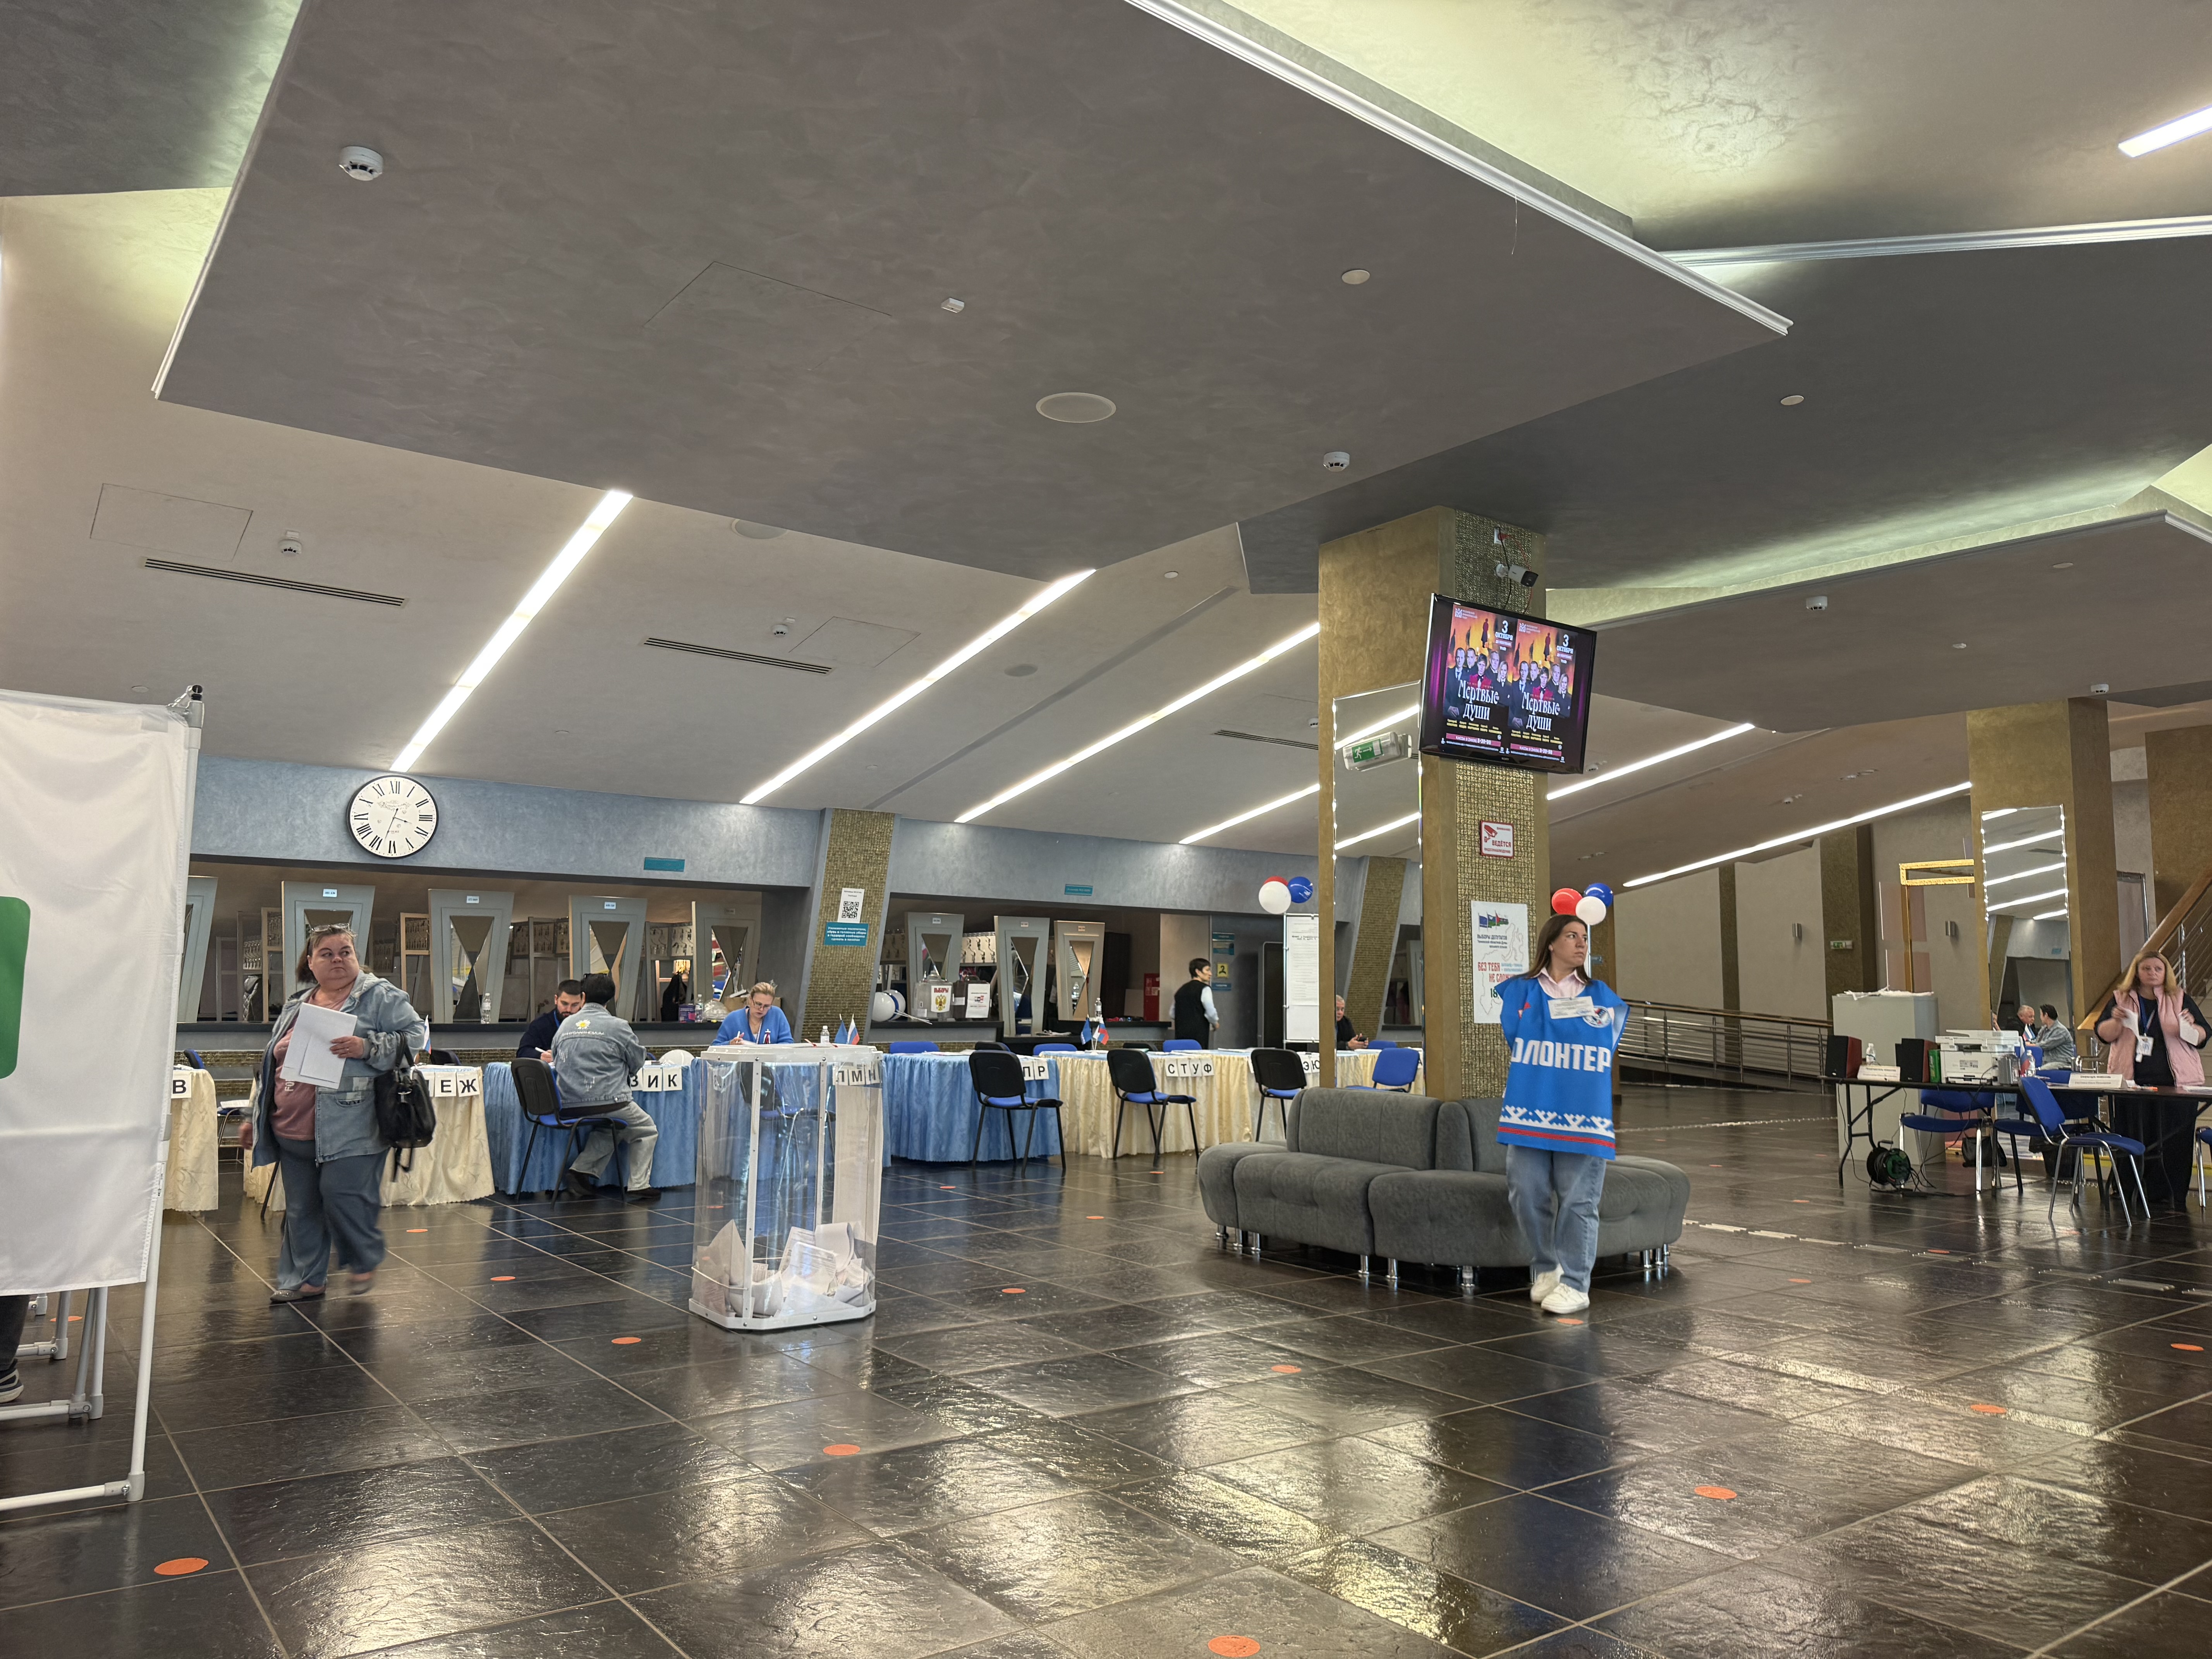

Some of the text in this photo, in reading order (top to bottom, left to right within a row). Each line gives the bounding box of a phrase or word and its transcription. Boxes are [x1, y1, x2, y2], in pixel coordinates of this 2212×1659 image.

[1502, 620, 1508, 633] 3
[1495, 632, 1513, 641] ОКТЯБРЯ
[1563, 634, 1569, 647] 3
[1478, 962, 1487, 971] БЕЗ
[1488, 962, 1500, 972] ТЕБЯ
[1489, 973, 1495, 982] НЕ
[1510, 1037, 1611, 1073] ОЛОНТЕР
[173, 1079, 187, 1094] В
[285, 1080, 295, 1092] FO
